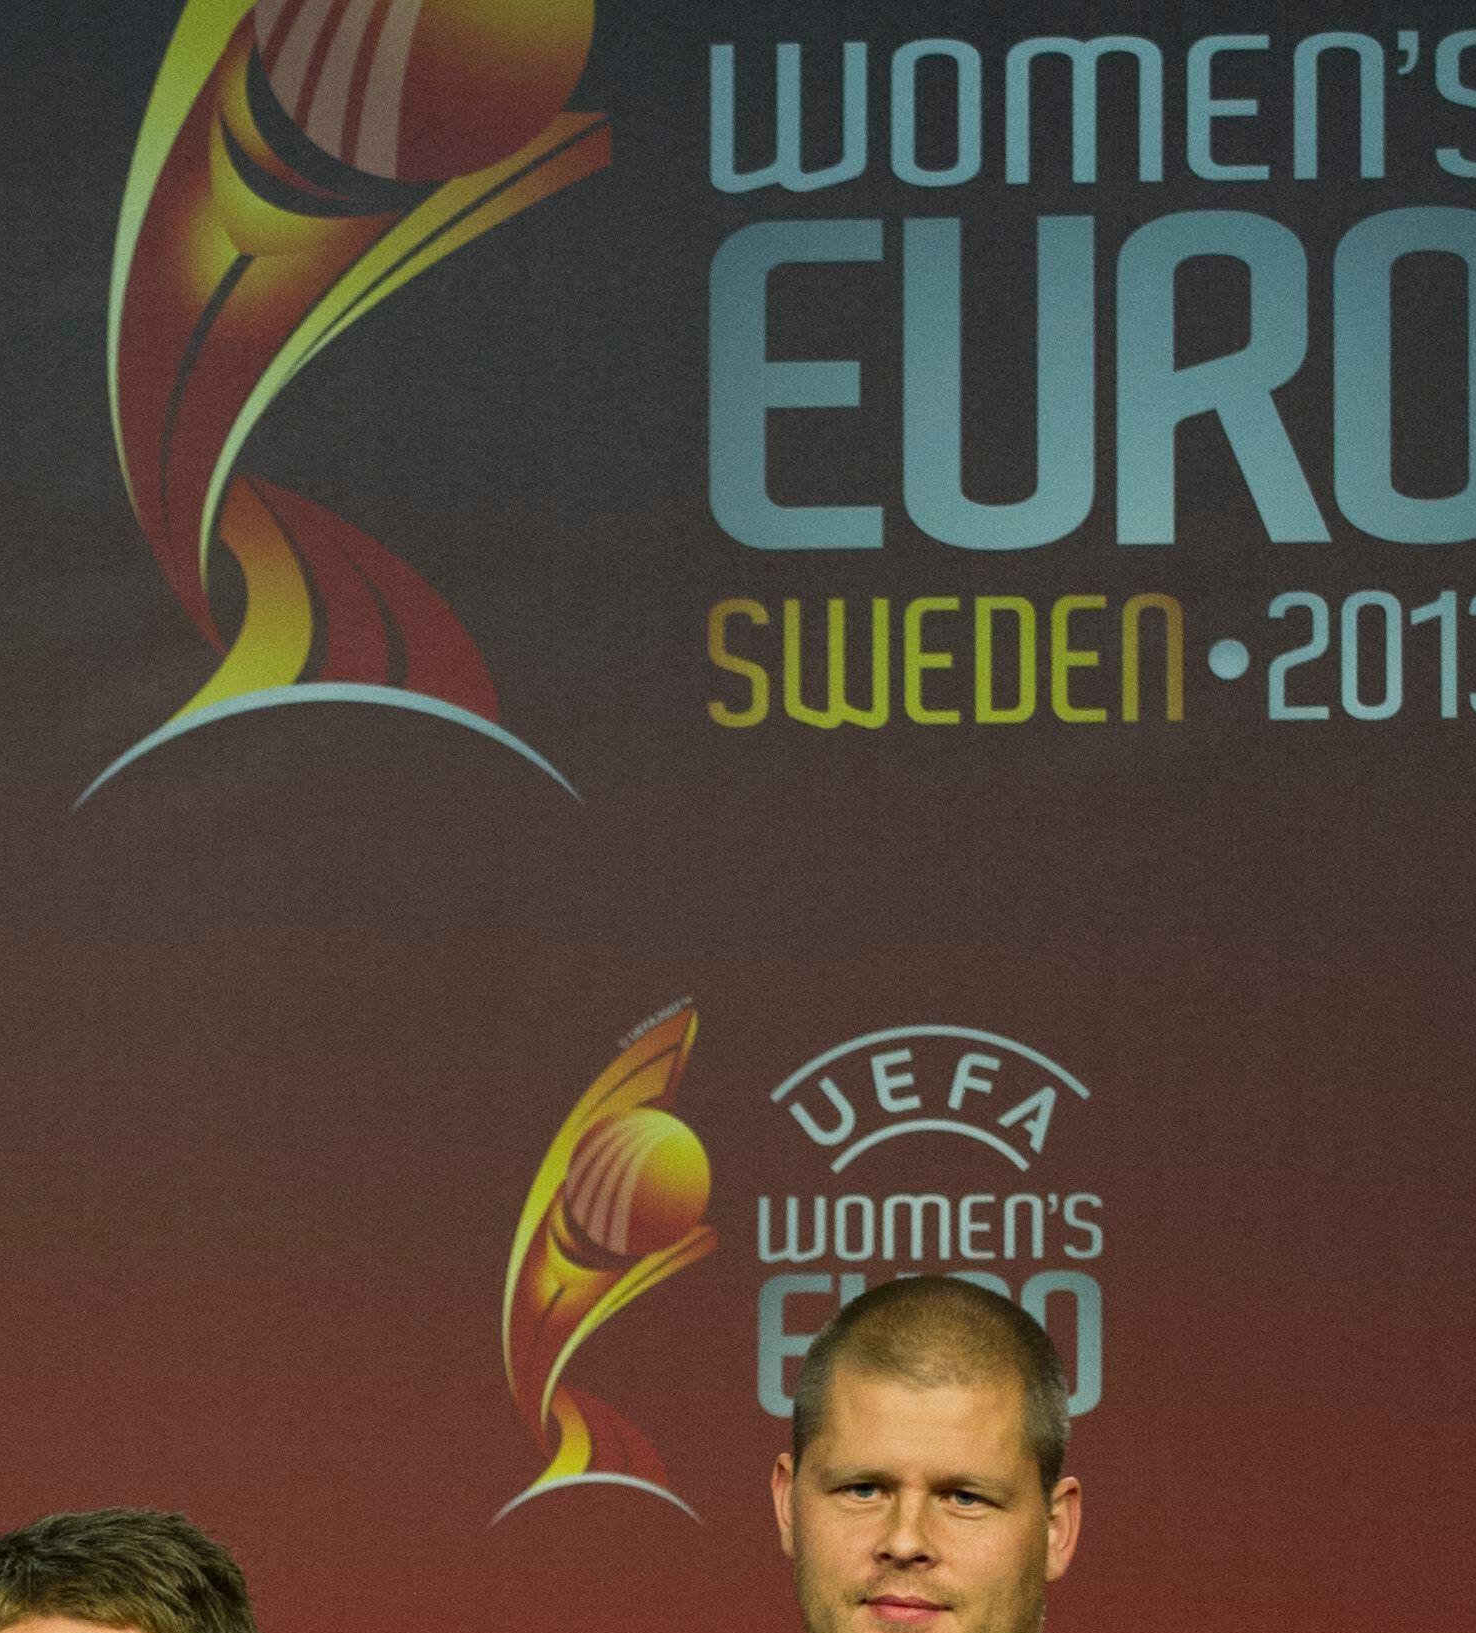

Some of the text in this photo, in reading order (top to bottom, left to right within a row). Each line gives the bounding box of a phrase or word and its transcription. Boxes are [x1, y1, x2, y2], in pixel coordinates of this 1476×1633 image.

[707, 593, 1185, 730] SWEDEN
[789, 1048, 1059, 1156] UEFA
[756, 1192, 1104, 1264] WOMEN'S
[756, 1270, 1104, 1419] EO
